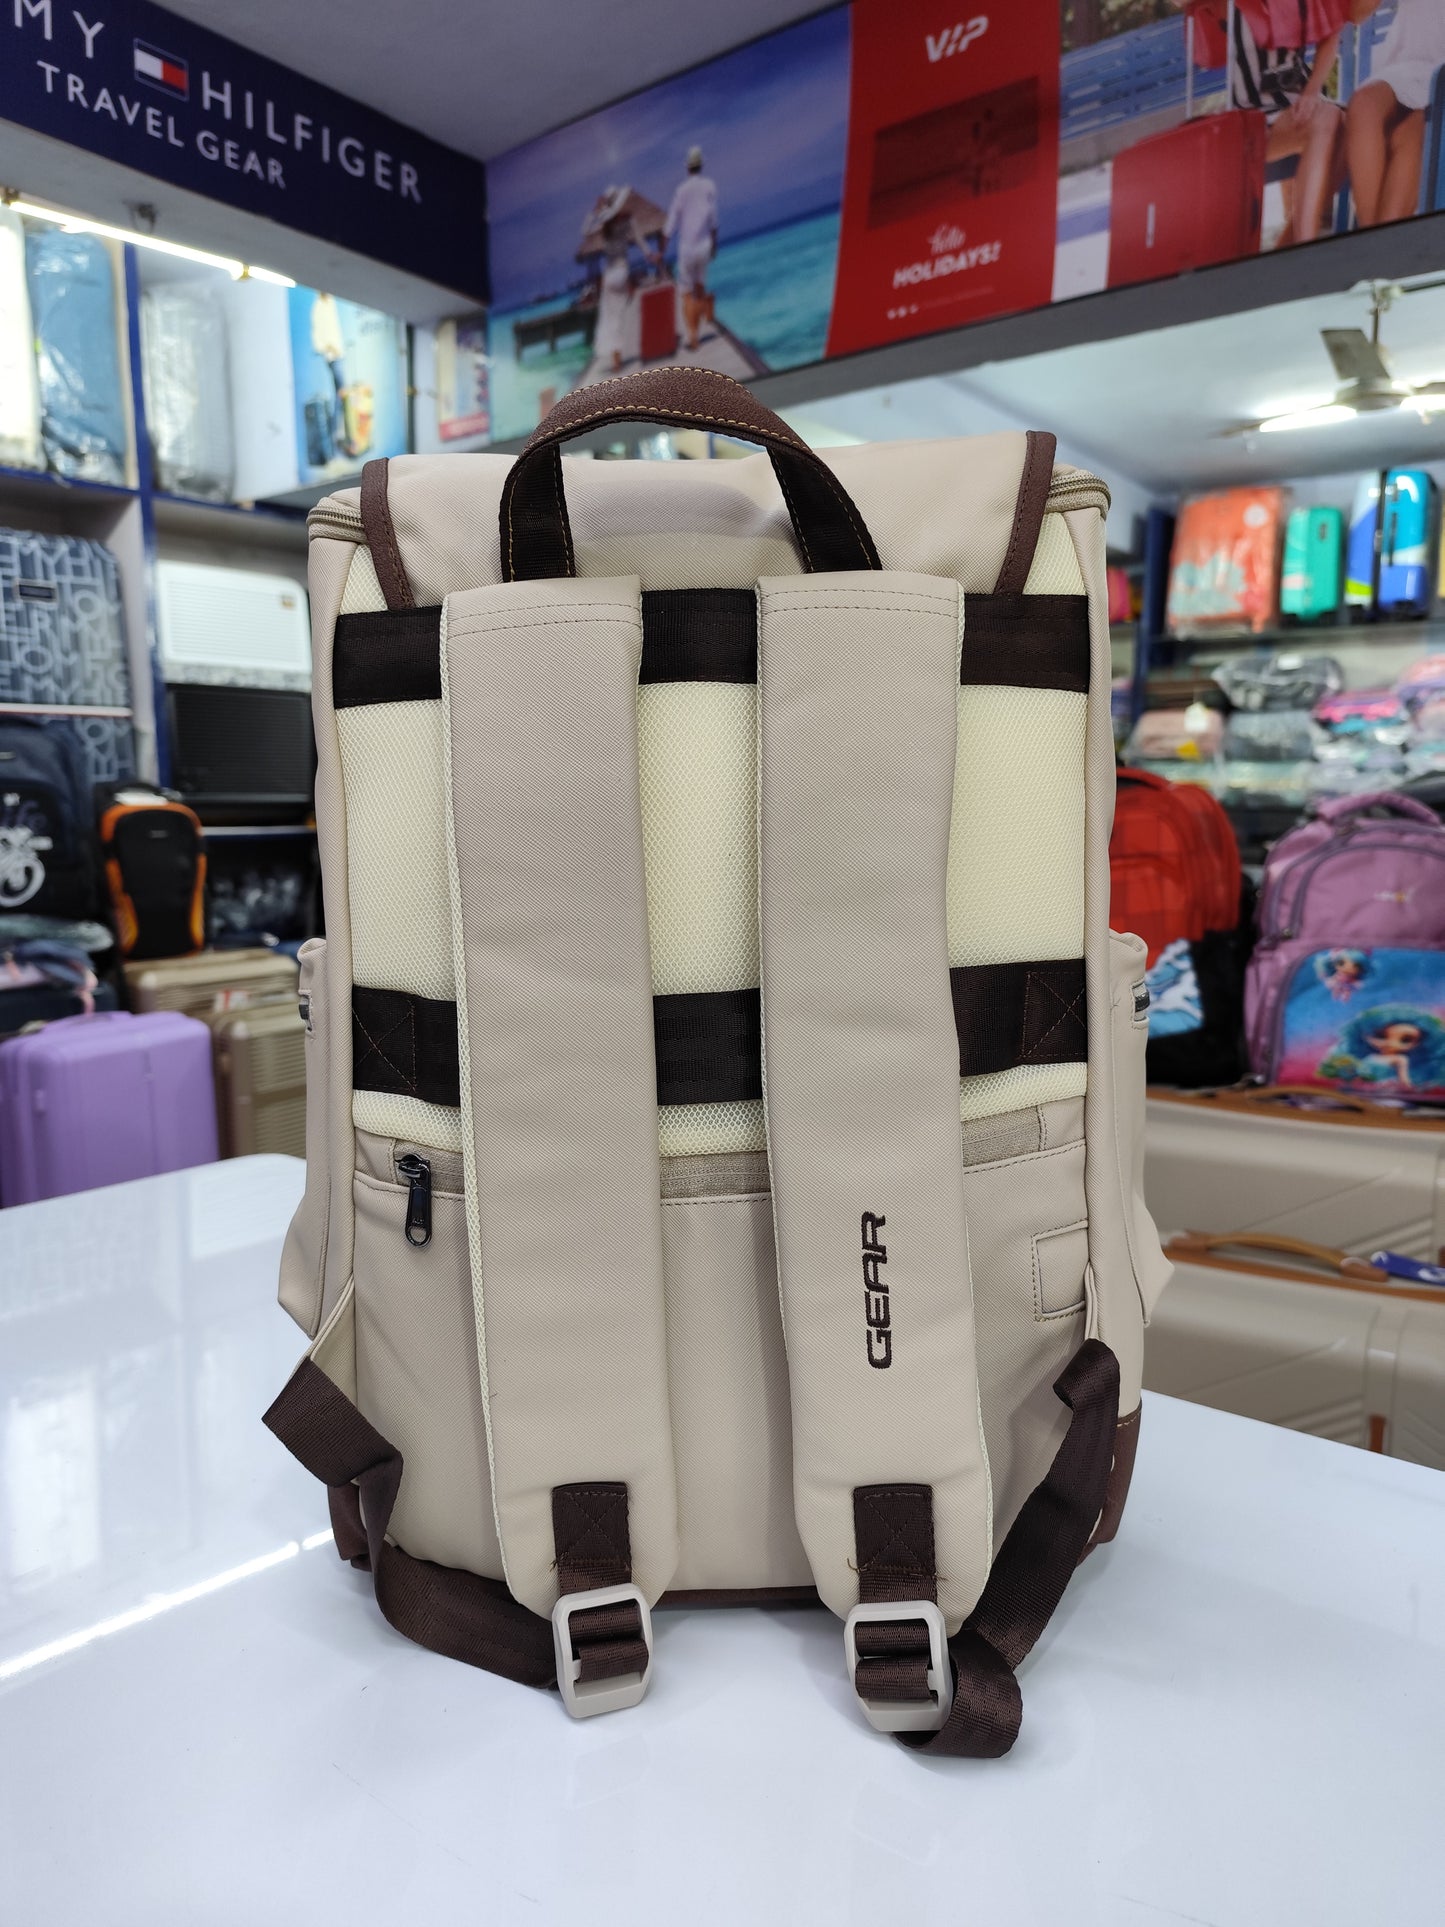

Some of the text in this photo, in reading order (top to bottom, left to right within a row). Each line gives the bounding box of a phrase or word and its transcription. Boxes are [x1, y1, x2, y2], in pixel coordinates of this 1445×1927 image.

[925, 15, 989, 63] VIP
[36, 60, 287, 189] TRAVEL GEAR
[202, 71, 422, 203] HILFIGER
[892, 240, 1002, 289] HOLIDAYS!
[861, 1211, 892, 1369] GEAR
